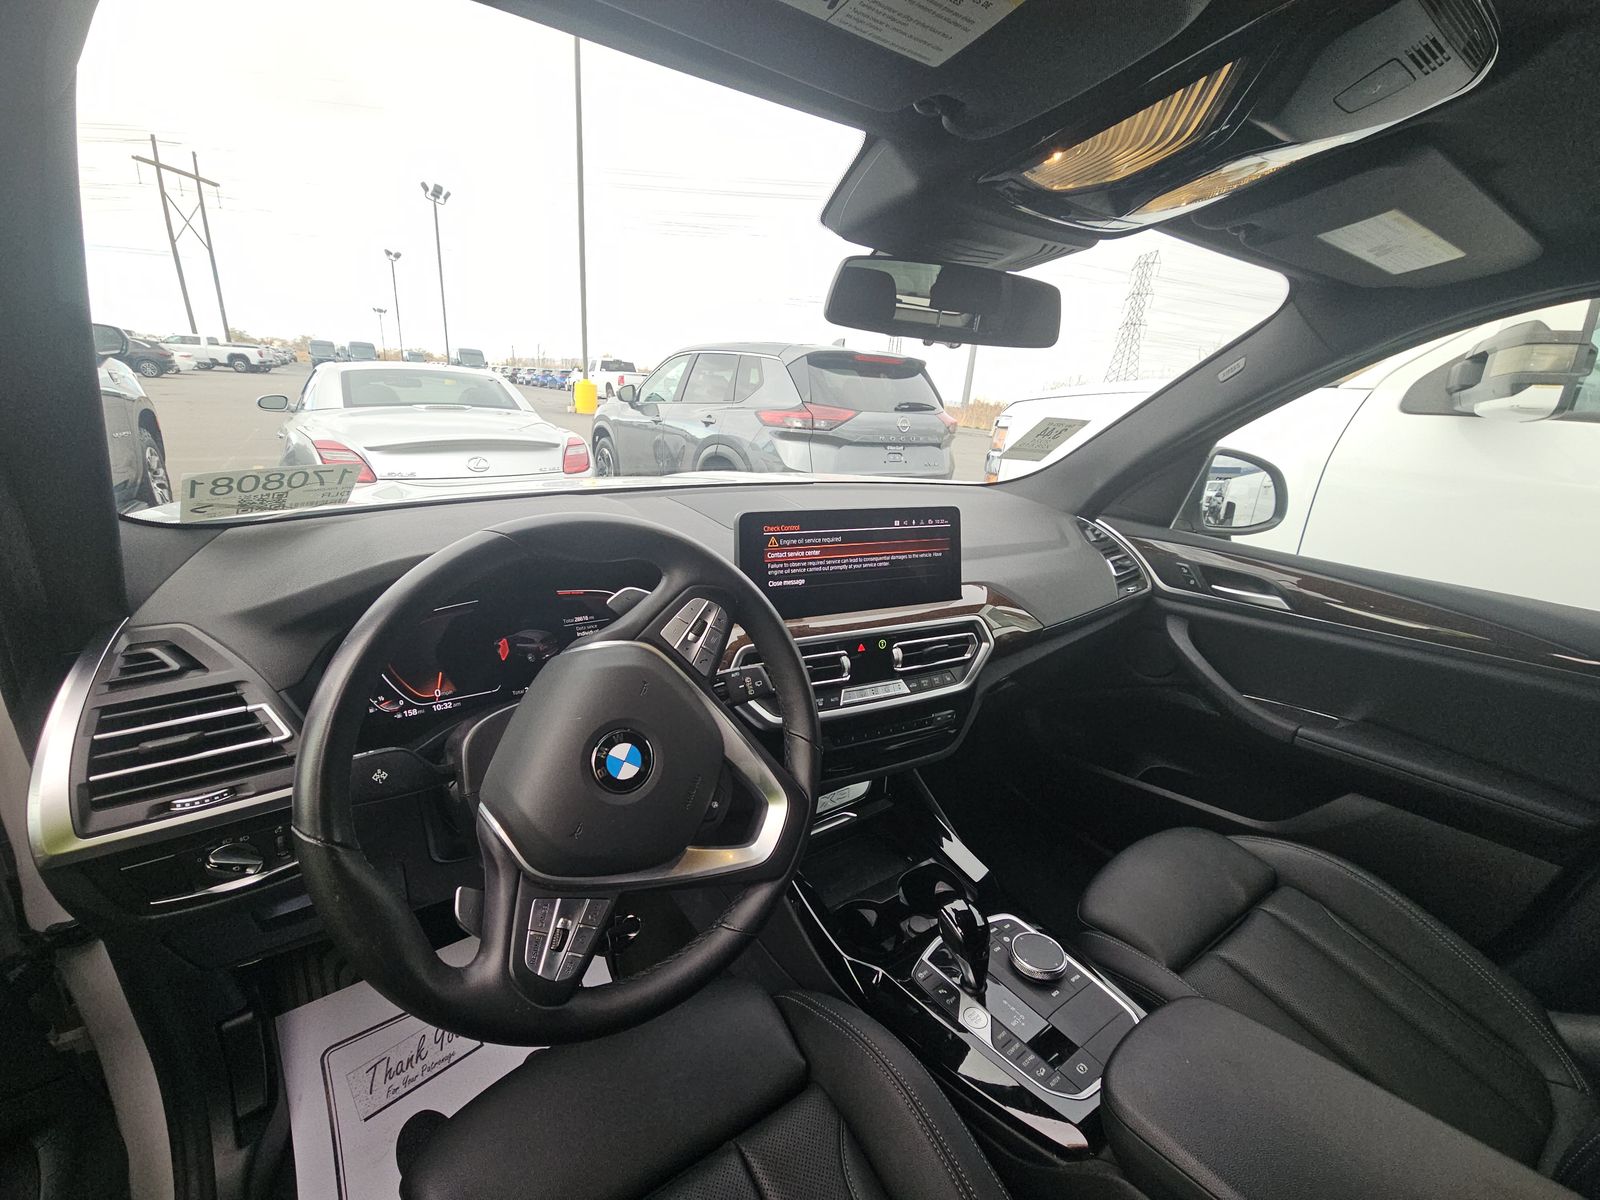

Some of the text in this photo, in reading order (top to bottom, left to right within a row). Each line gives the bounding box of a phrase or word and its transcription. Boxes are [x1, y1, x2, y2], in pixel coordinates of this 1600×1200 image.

[434, 689, 440, 697] 0
[432, 702, 452, 711] 10:32
[403, 709, 418, 717] 158
[365, 1028, 460, 1095] Thank Yo
[386, 1051, 456, 1099] For Your Patronage
